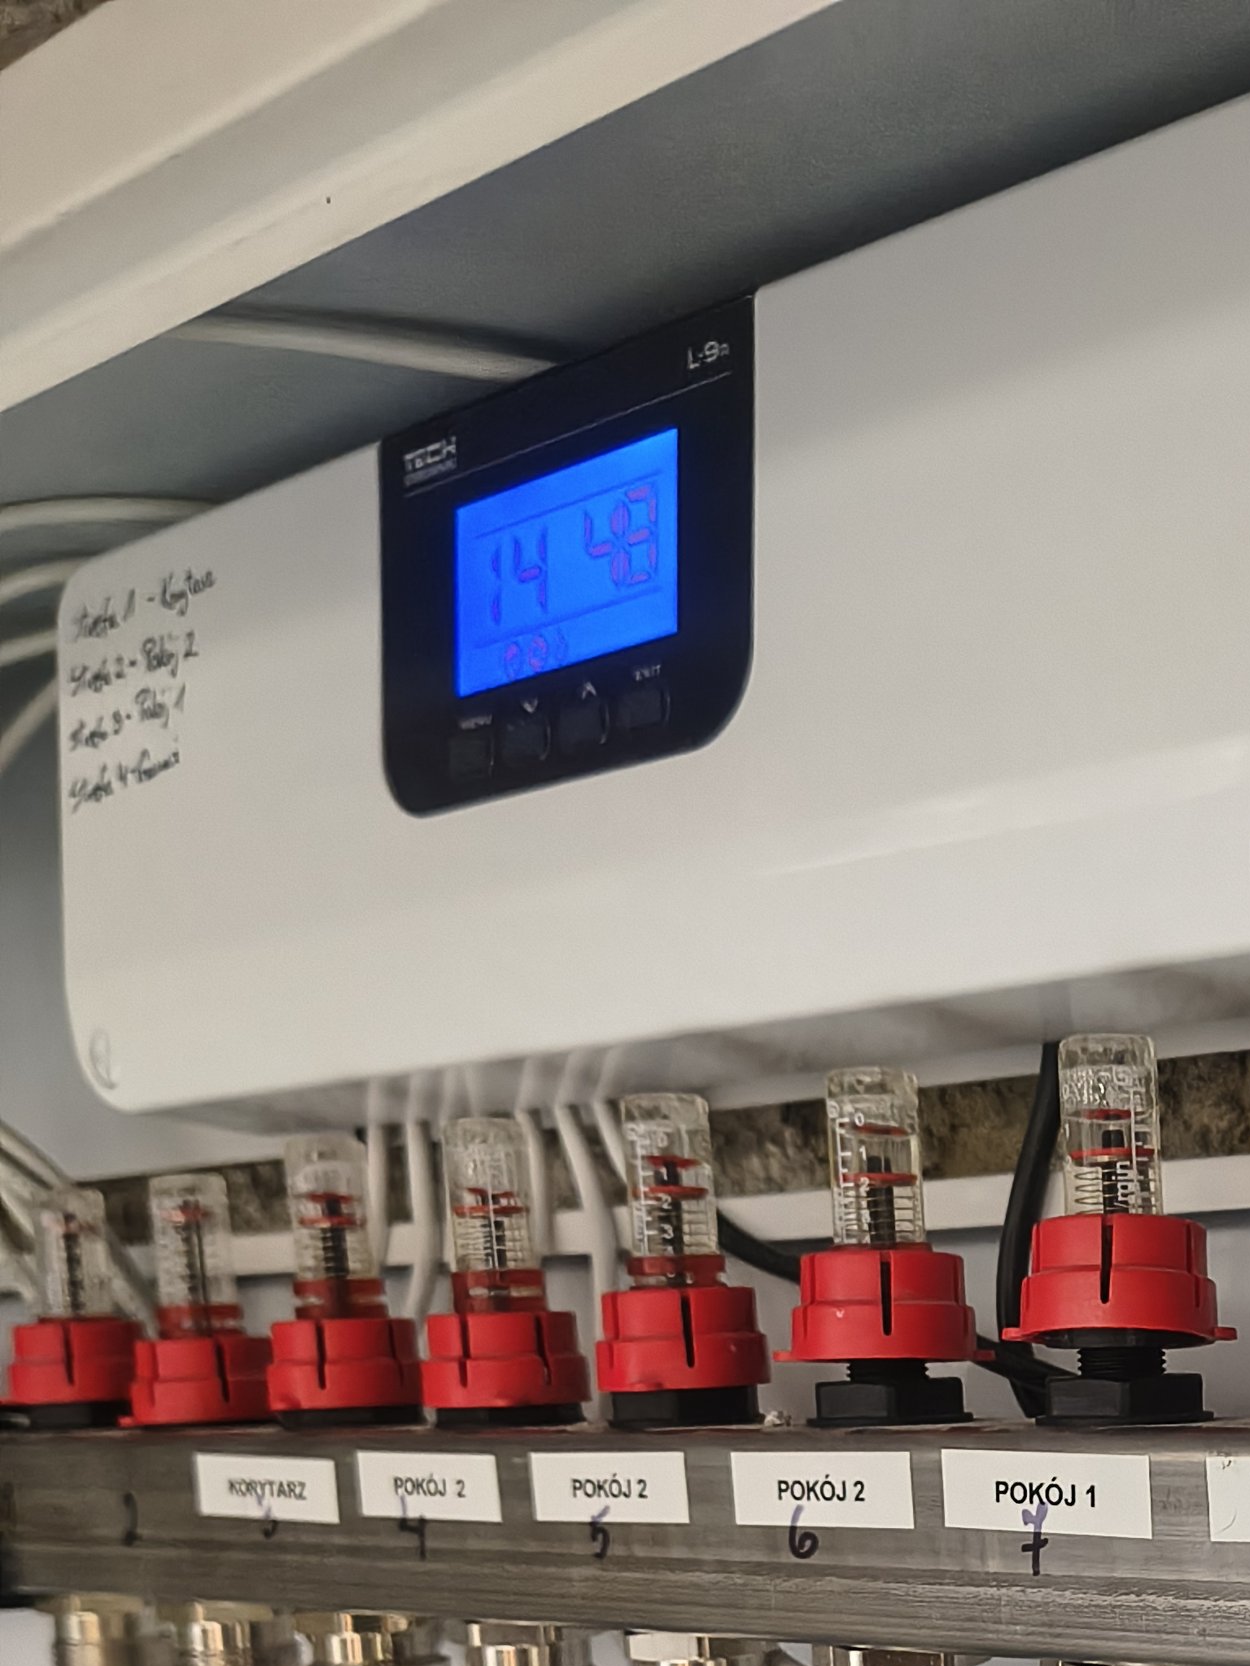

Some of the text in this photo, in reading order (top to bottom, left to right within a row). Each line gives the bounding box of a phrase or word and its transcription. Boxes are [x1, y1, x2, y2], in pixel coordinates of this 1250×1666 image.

[228, 1478, 307, 1500] KORYTARZ
[394, 1473, 467, 1498] POKÓJ 2
[571, 1473, 649, 1499] POKÓJ 2
[777, 1474, 866, 1502] POKÓJ 2
[995, 1476, 1096, 1508] POKÓJ 1
[589, 1505, 610, 1559] 5
[788, 1504, 819, 1559] 6
[1021, 1501, 1049, 1577] 7
